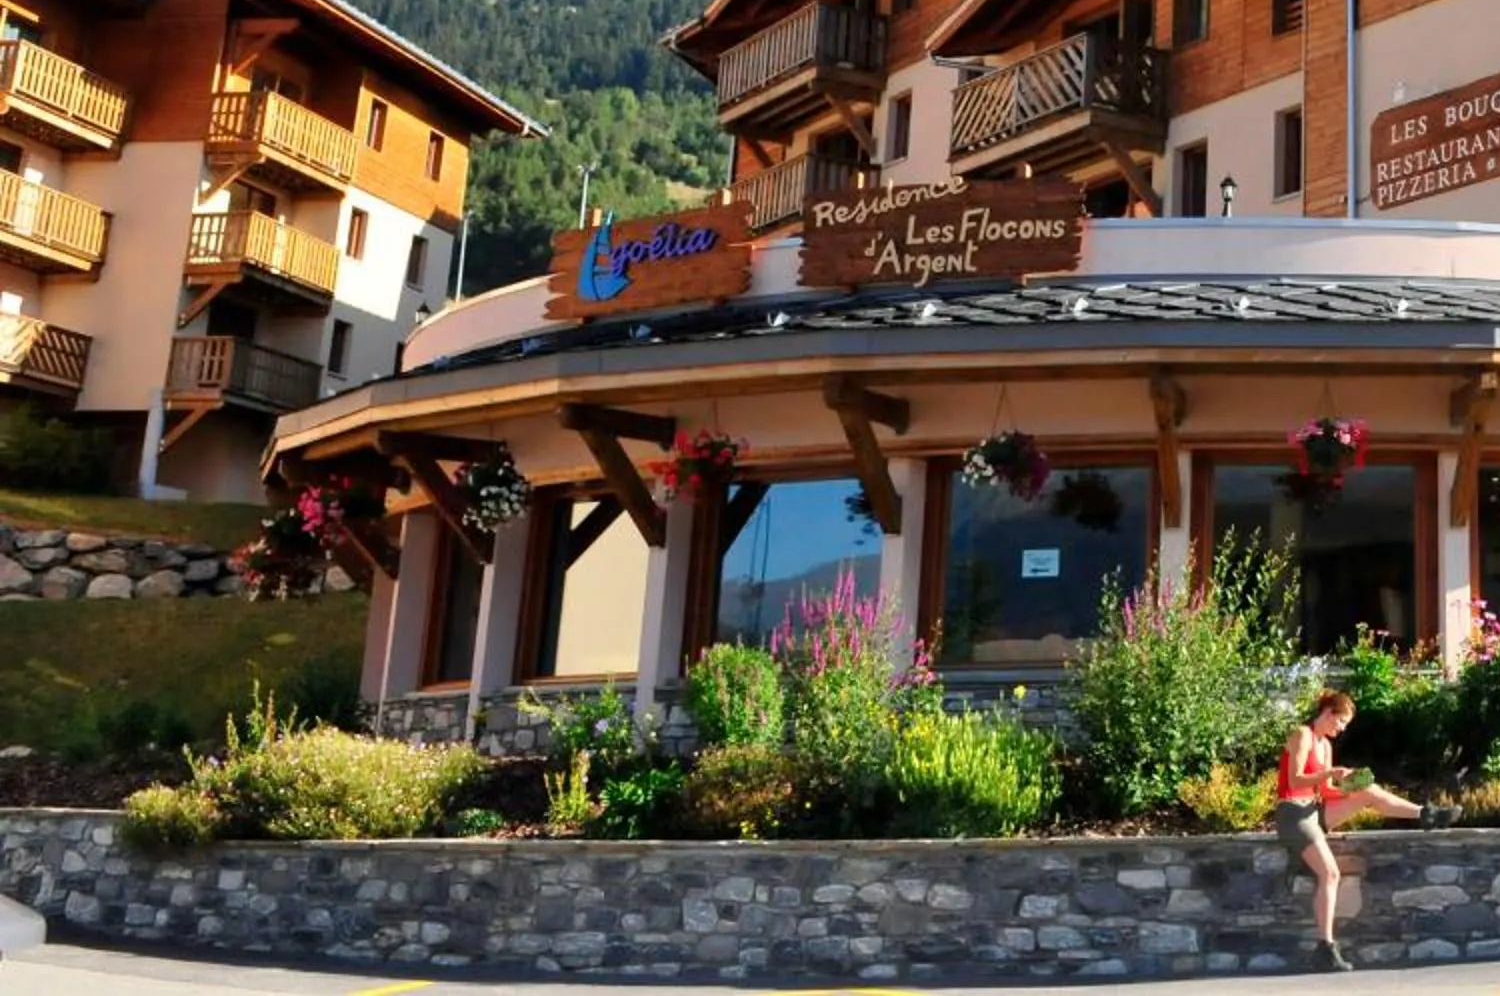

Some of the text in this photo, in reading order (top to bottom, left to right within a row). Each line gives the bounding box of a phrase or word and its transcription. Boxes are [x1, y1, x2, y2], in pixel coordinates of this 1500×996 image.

[1390, 115, 1428, 146] LES
[812, 175, 969, 227] Residence
[1376, 164, 1477, 206] PIZZERIA
[905, 214, 955, 245] Les
